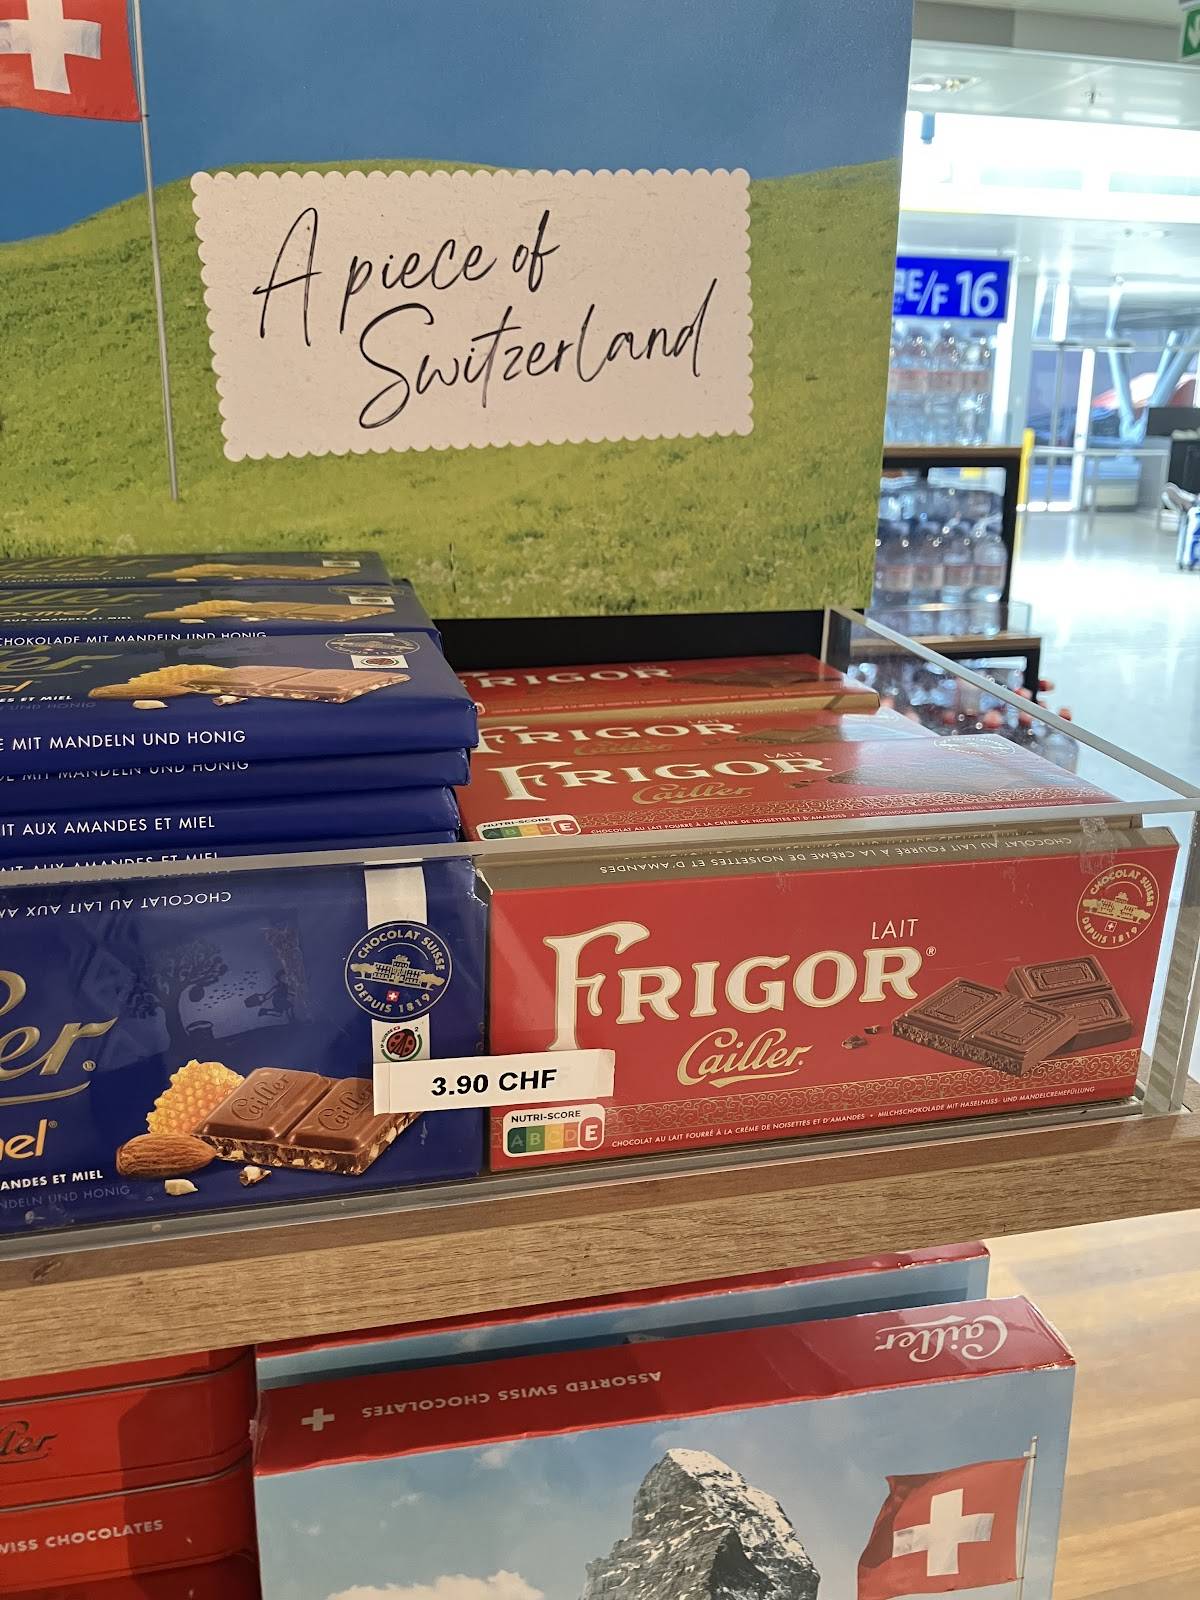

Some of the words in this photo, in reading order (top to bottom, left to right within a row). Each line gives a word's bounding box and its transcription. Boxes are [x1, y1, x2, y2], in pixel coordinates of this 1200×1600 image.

[252, 207, 322, 346] A
[339, 239, 496, 334] piece
[512, 209, 560, 292] of
[956, 269, 999, 317] 16
[358, 278, 717, 430] Switzerland
[12, 737, 42, 750] MIT
[49, 733, 136, 750] MANDELN
[143, 732, 180, 747] UND
[187, 730, 247, 745] HONIG
[763, 751, 804, 759] LAIT
[486, 758, 832, 801] FRIGOR
[632, 782, 753, 804] Cailler
[23, 822, 57, 835] AUX
[64, 818, 147, 834] AMANDES
[155, 818, 172, 830] ET
[178, 816, 215, 829] MIEL
[483, 818, 552, 828] NUTRI-SCORE
[559, 822, 574, 832] E
[896, 846, 946, 856] FOURRÉ
[951, 843, 977, 852] LAIT
[981, 840, 998, 849] AU
[1004, 836, 1072, 848] CHOCOLAT
[691, 859, 706, 867] ET
[712, 855, 783, 865] NOISETTES
[788, 853, 800, 861] DE
[811, 850, 855, 861] CRÈME
[860, 849, 876, 858] LA
[600, 860, 685, 873] D'AMANDES
[1090, 869, 1141, 895] CHOCOLAT
[68, 901, 102, 914] LAIT
[110, 898, 134, 911] AU
[141, 891, 232, 909] CHOCOLAT
[26, 904, 61, 917] AUX
[871, 918, 918, 941] LAIT
[1082, 916, 1108, 944] DEPUIS
[357, 929, 421, 959] CHOCOLAT
[421, 936, 446, 971] SUISSE
[543, 920, 923, 1051] FRIGOR
[354, 982, 393, 1013] DEPUIS
[398, 993, 430, 1013] 1819
[677, 1028, 814, 1088] Cailler
[431, 1074, 489, 1096] 3.90
[498, 1068, 557, 1091] CHF
[878, 1103, 945, 1118] MILCHSCHOKOLADE
[946, 1101, 959, 1109] MIT
[1003, 1095, 1017, 1104] UND
[511, 1110, 581, 1123] NUTRI-SCORE
[585, 1124, 598, 1141] E
[611, 1136, 652, 1148] CHOCOLAT
[655, 1134, 667, 1143] AU
[668, 1132, 684, 1142] LAIT
[685, 1128, 714, 1140] FOURRÉ
[716, 1127, 722, 1136] À
[724, 1127, 733, 1136] LA
[761, 1122, 771, 1131] DE
[772, 1119, 811, 1130] NOISETTES
[812, 1117, 821, 1126] ET
[822, 1113, 865, 1124] D'AMANDES
[52, 1173, 67, 1185] ET
[72, 1169, 104, 1182] MIEL
[48, 1191, 78, 1204] UND
[83, 1185, 131, 1199] HONIG
[874, 1315, 1008, 1363] Cailler
[566, 1371, 662, 1393] ASSORTED
[498, 1384, 558, 1401] SWISS
[362, 1393, 490, 1418] CHOCOLATES
[45, 1519, 164, 1548] CHOCOLATES
